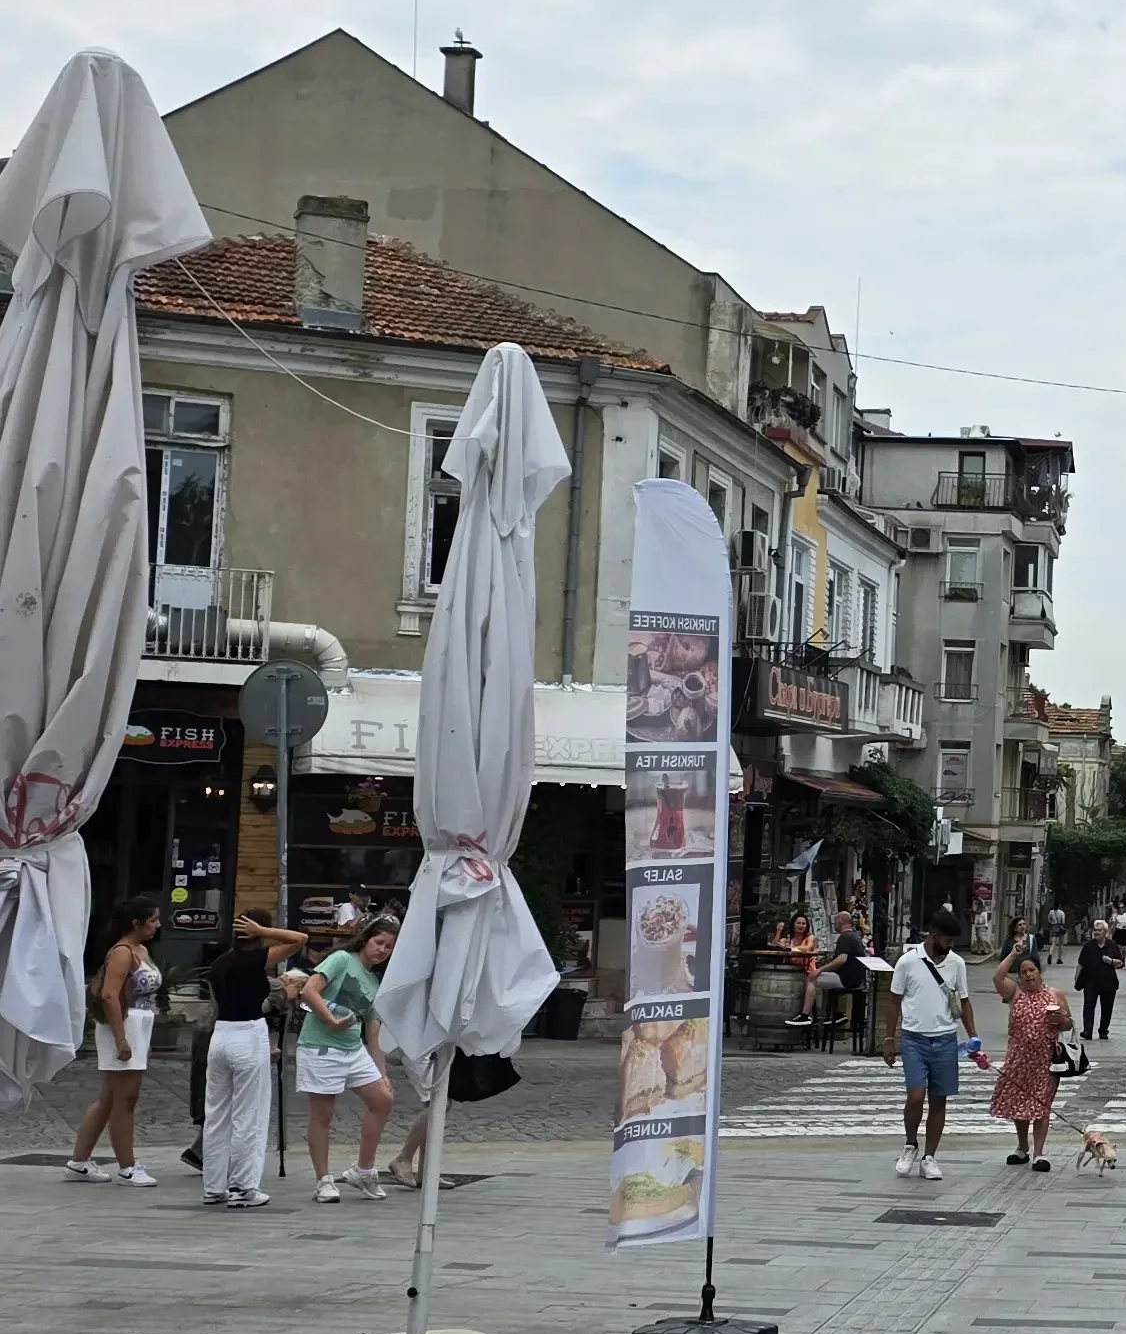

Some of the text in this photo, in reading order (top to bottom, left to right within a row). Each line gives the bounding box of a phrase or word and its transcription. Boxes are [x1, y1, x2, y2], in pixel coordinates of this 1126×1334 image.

[160, 727, 215, 741] FISH
[350, 720, 410, 753] FI
[159, 739, 214, 749] EXPRESS
[382, 827, 420, 837] EXPR
